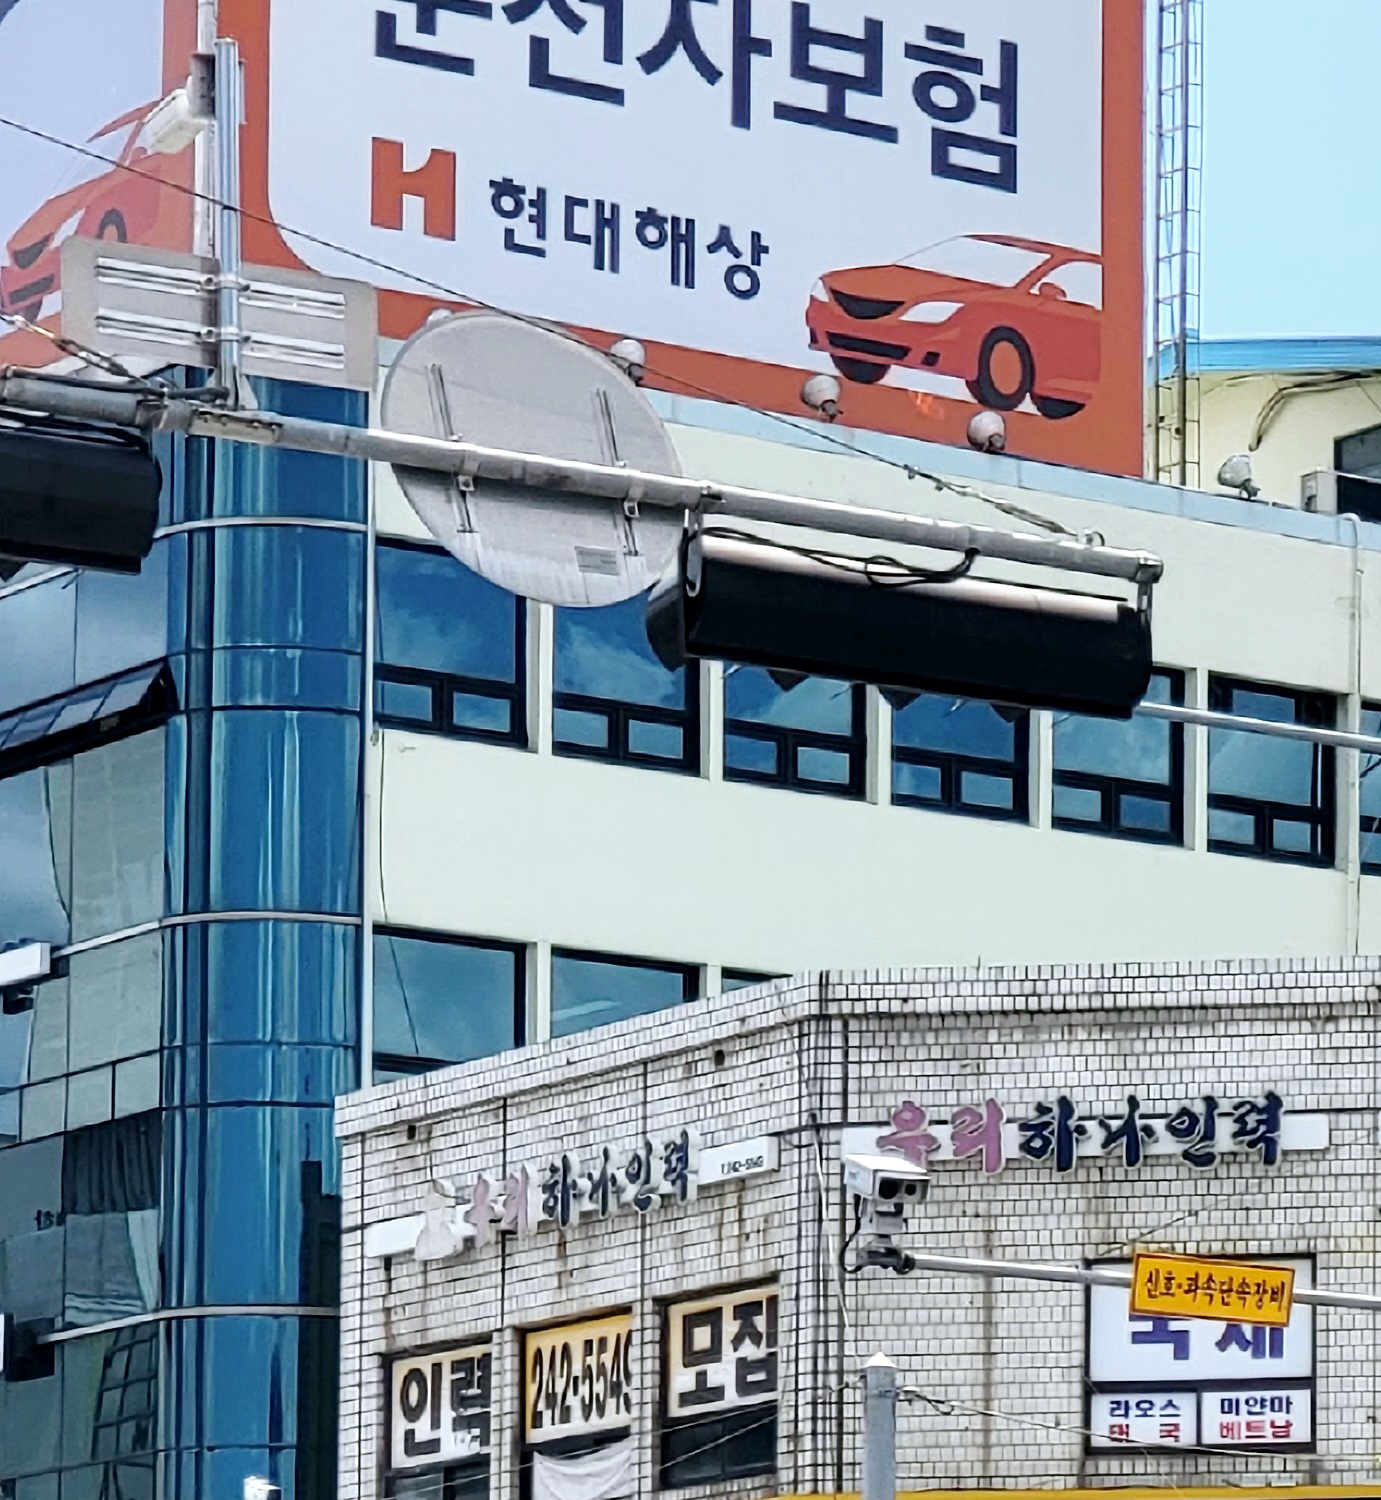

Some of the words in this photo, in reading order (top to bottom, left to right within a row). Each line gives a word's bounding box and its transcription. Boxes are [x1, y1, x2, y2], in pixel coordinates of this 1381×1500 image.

[489, 176, 771, 300] 현대해상
[678, 1295, 778, 1409] 모집
[400, 1352, 491, 1457] 인력
[1108, 1399, 1182, 1418] 라오스
[1219, 1418, 1293, 1440] 베트남
[1220, 1396, 1293, 1417] 미얀마
